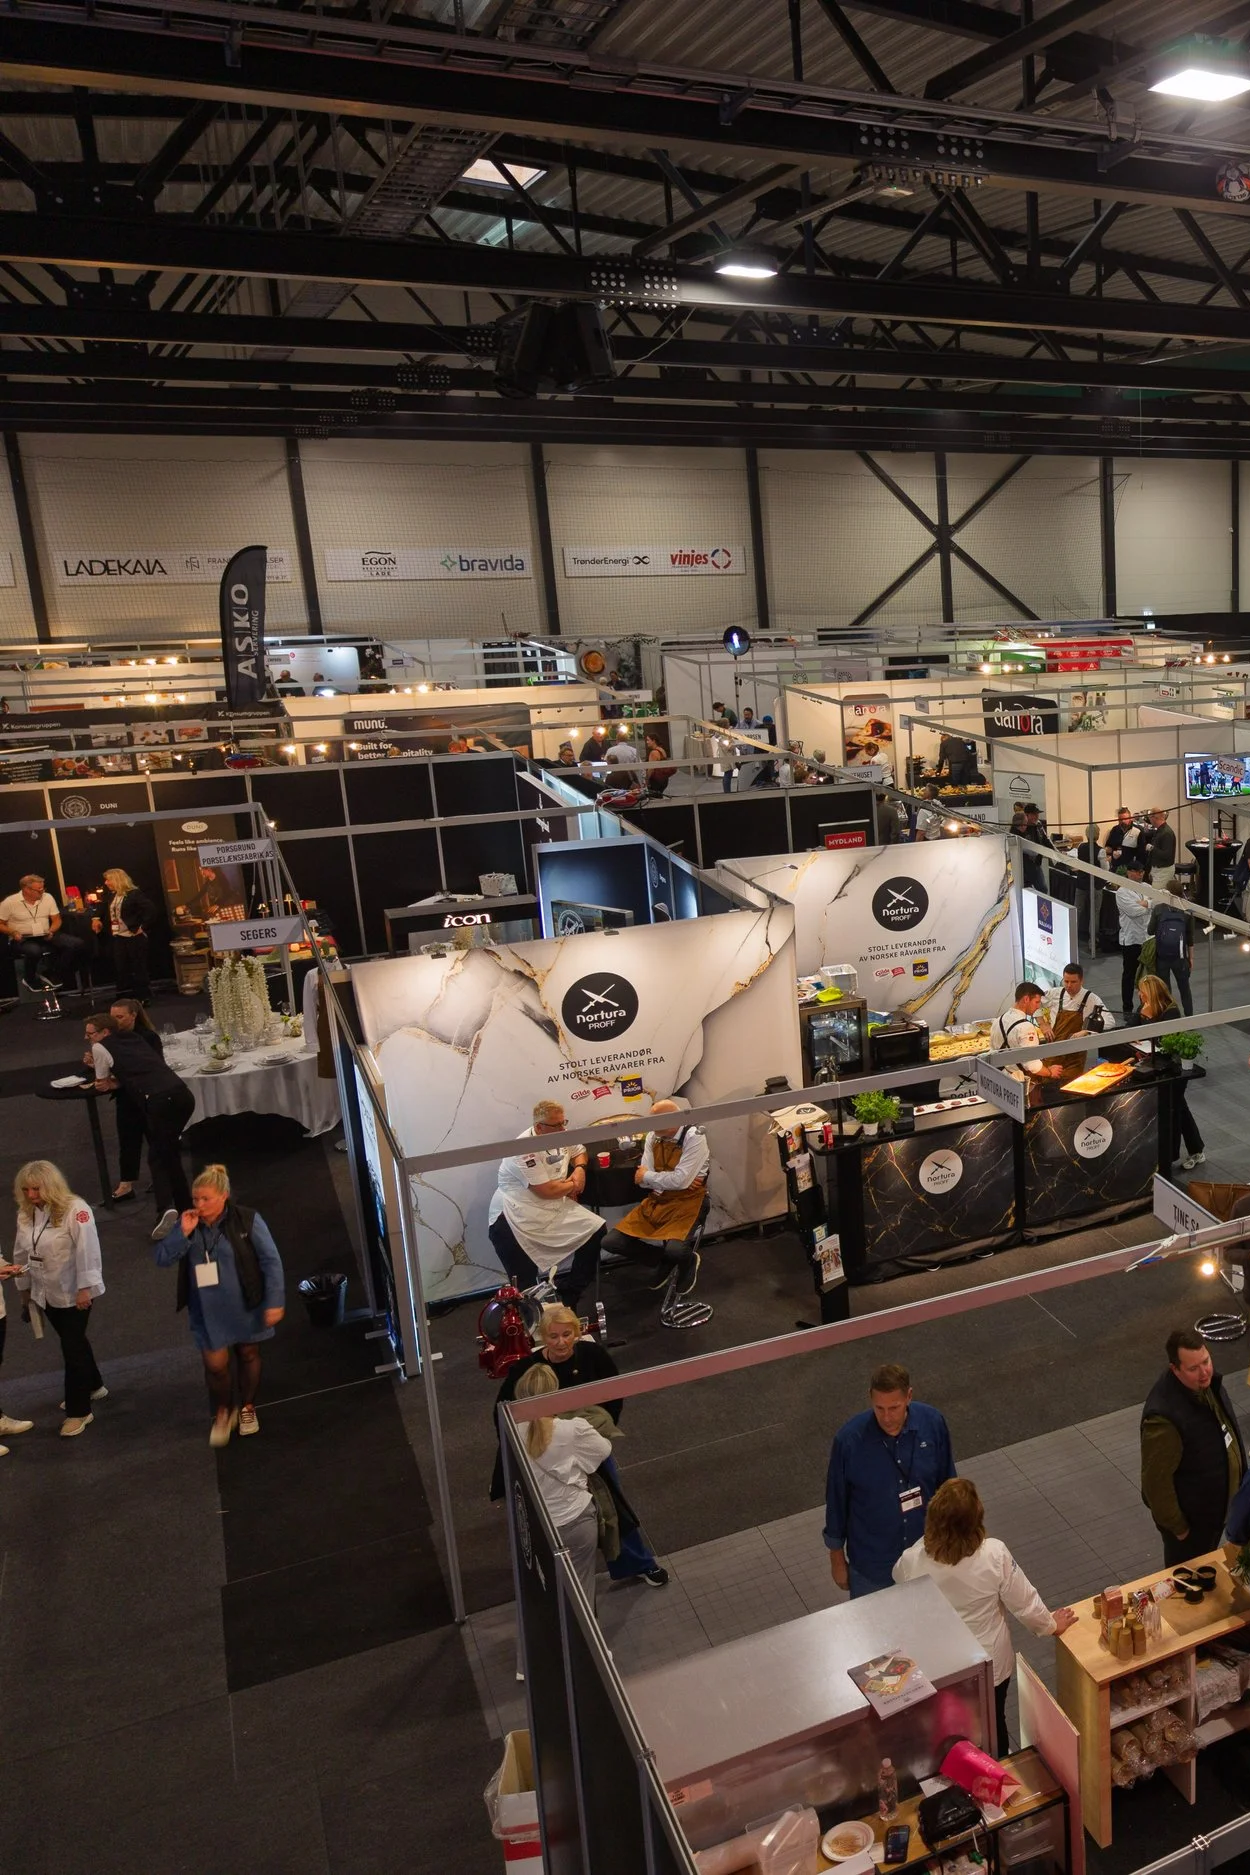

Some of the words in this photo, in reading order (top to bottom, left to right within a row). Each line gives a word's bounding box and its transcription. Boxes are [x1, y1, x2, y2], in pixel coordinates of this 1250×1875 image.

[361, 557, 397, 566] EGON
[459, 554, 524, 571] bravida
[572, 557, 629, 566] TrønderEnergi
[670, 549, 708, 567] vinjes
[63, 559, 167, 577] LADEKAIA
[250, 609, 259, 656] SERVERING
[379, 741, 393, 749] for
[1218, 760, 1244, 776] Scandic
[216, 843, 256, 854] PORSGRUND
[828, 836, 863, 847] MYDLAND
[202, 852, 265, 865] PORSELÆNSFABRIK
[265, 850, 274, 858] AS
[882, 906, 920, 916] nortura
[891, 914, 910, 922] PROFF
[443, 912, 491, 928] icon
[240, 928, 277, 941] SEGERS
[868, 945, 889, 953] STOLT
[891, 938, 937, 950] LEVERANDØR
[870, 952, 898, 961] NORSKE
[900, 947, 931, 957] RÅVARER
[576, 1007, 627, 1025] nortura
[588, 1019, 616, 1030] PROFF
[559, 1059, 588, 1071] STOLT
[590, 1047, 652, 1065] LEVERANDØR
[547, 1075, 560, 1084] AV
[562, 1067, 601, 1081] NORSKE
[603, 1059, 645, 1073] RÅVARER
[647, 1055, 665, 1067] FRA
[571, 1089, 591, 1100] Gilde
[980, 1074, 1003, 1098] NORTURA
[1003, 1086, 1020, 1107] PROFF
[1080, 1137, 1106, 1147] nortura
[927, 1171, 956, 1183] nortura
[1173, 1204, 1190, 1231] TINE
